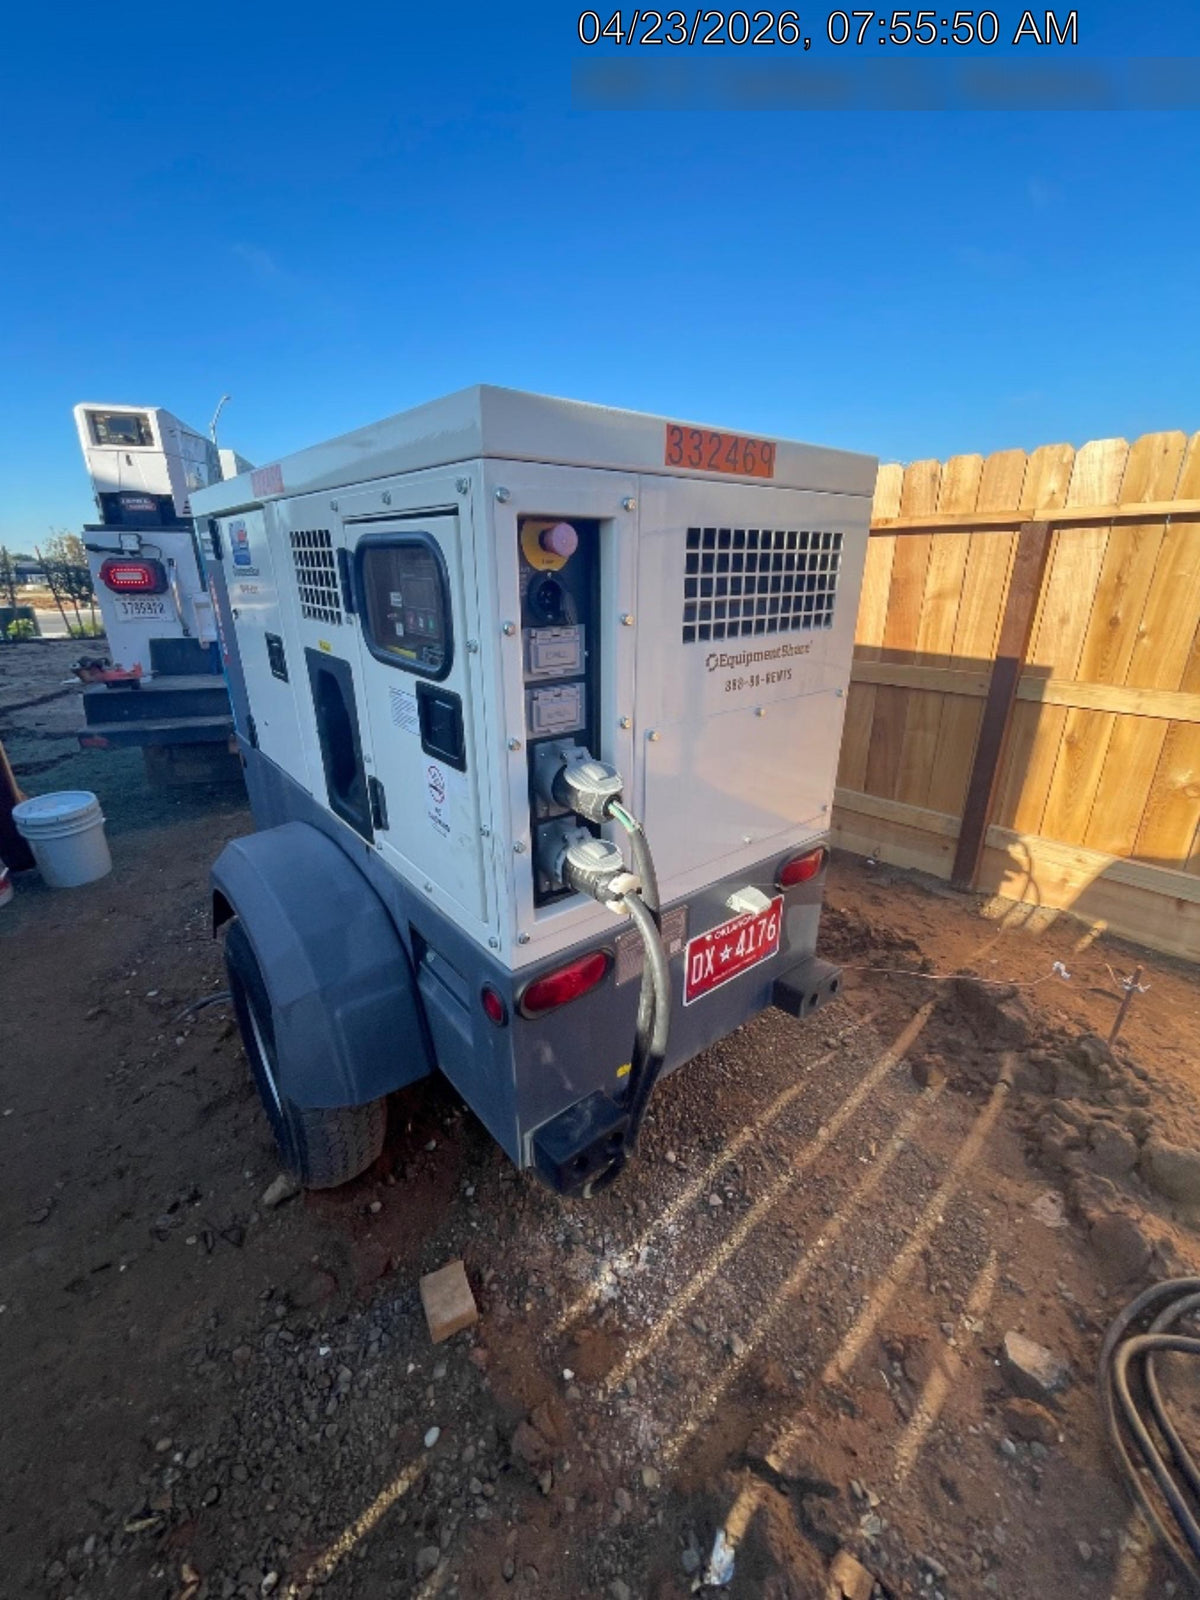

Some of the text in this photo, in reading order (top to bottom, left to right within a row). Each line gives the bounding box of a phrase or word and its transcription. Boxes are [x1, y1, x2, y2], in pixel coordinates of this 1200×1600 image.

[668, 424, 774, 478] 332469
[719, 643, 811, 669] EquipmentShare
[714, 914, 759, 939] OKLAHO
[691, 945, 716, 986] DX
[735, 913, 776, 957] 4176
